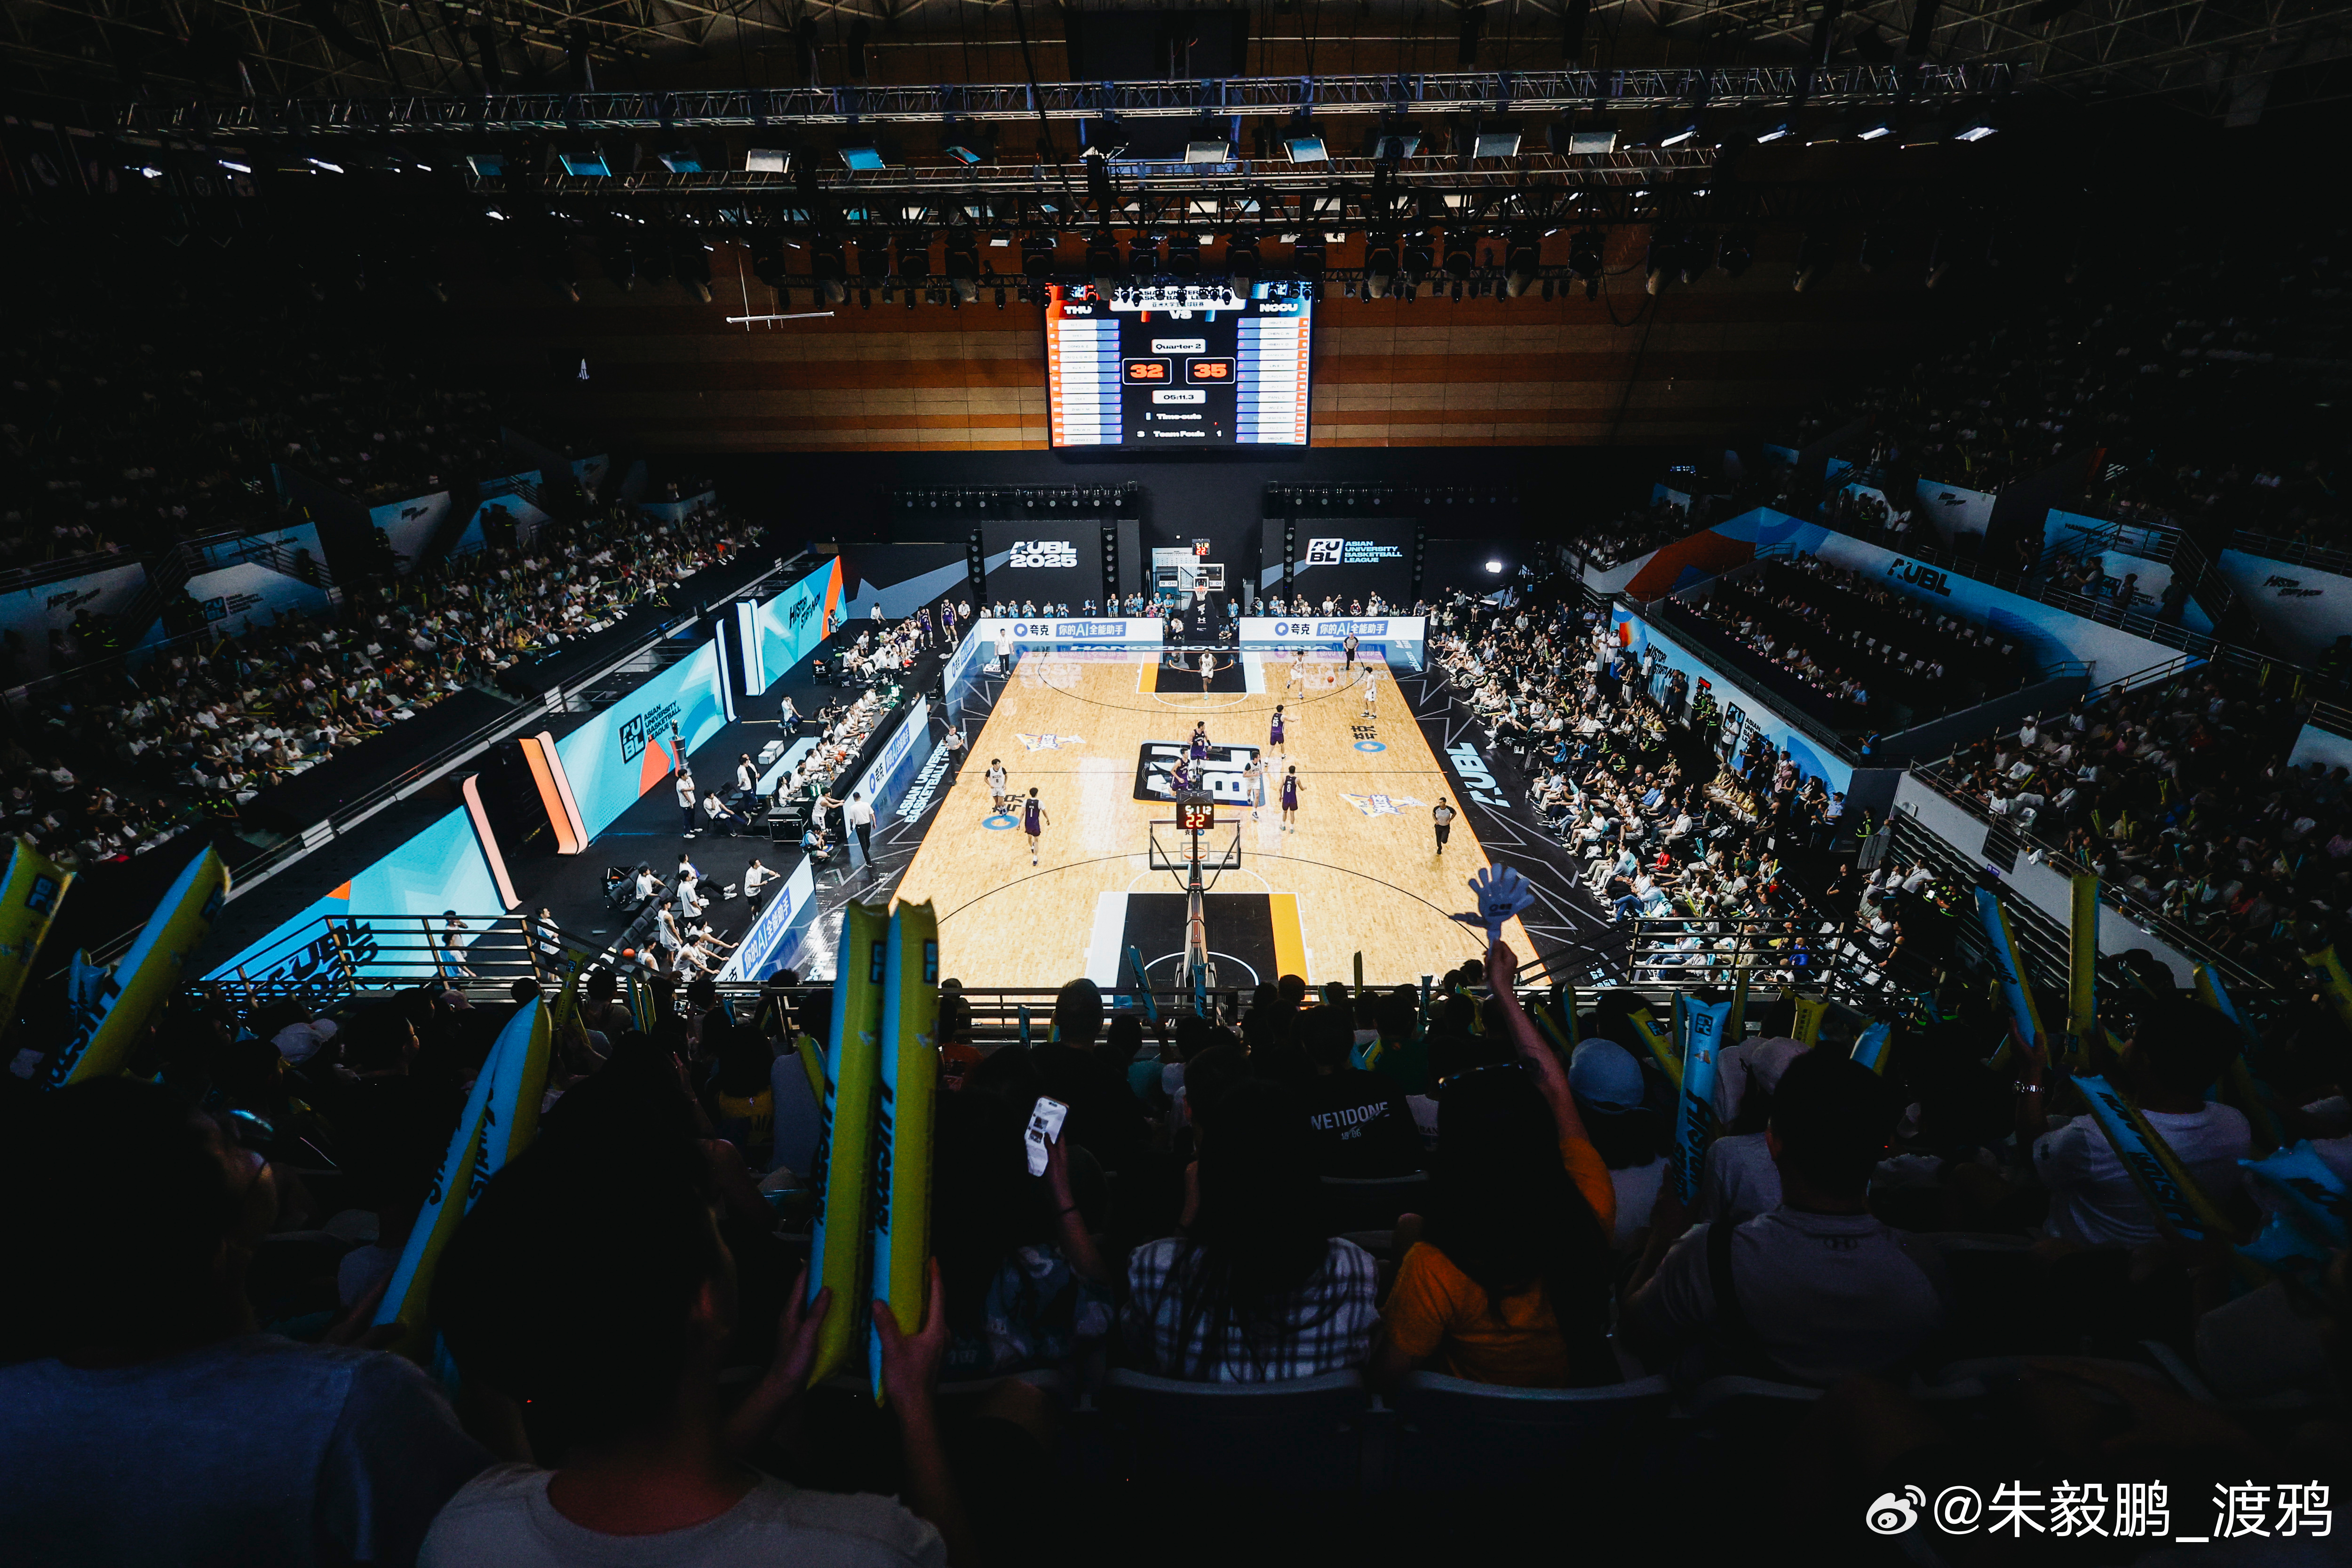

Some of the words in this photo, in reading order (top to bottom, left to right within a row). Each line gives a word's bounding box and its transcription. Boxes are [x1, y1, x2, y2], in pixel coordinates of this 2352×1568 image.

[1064, 306, 1092, 314] THU
[1169, 310, 1192, 319] VS
[1259, 303, 1298, 312] NCCU
[1130, 364, 1164, 378] 32
[1194, 363, 1227, 378] 35
[1010, 541, 1077, 554] AUBL
[1010, 554, 1078, 568] 2025
[1310, 552, 1338, 562] BL
[1886, 558, 1951, 597] AUBL
[1030, 624, 1049, 636] 夸克
[1058, 624, 1124, 637] 你的AI全能助手
[1291, 624, 1310, 635] 夸克
[1319, 623, 1385, 636] 你的AI全能助手
[644, 704, 661, 721] ASIAN
[645, 700, 676, 728] UNIVERSITY
[646, 706, 681, 735] BASKETBALL
[1745, 717, 1761, 732] ASIAN
[648, 723, 669, 742] LEAGUE
[624, 735, 644, 761] BL
[1446, 742, 1511, 808] AUBL
[904, 763, 950, 823] BASKETBALL
[1287, 784, 1291, 793] 8
[896, 786, 922, 817] ASIAN
[1030, 808, 1033, 818] 1
[1185, 814, 1205, 828] 22
[743, 893, 790, 973] 你的AI全能助手
